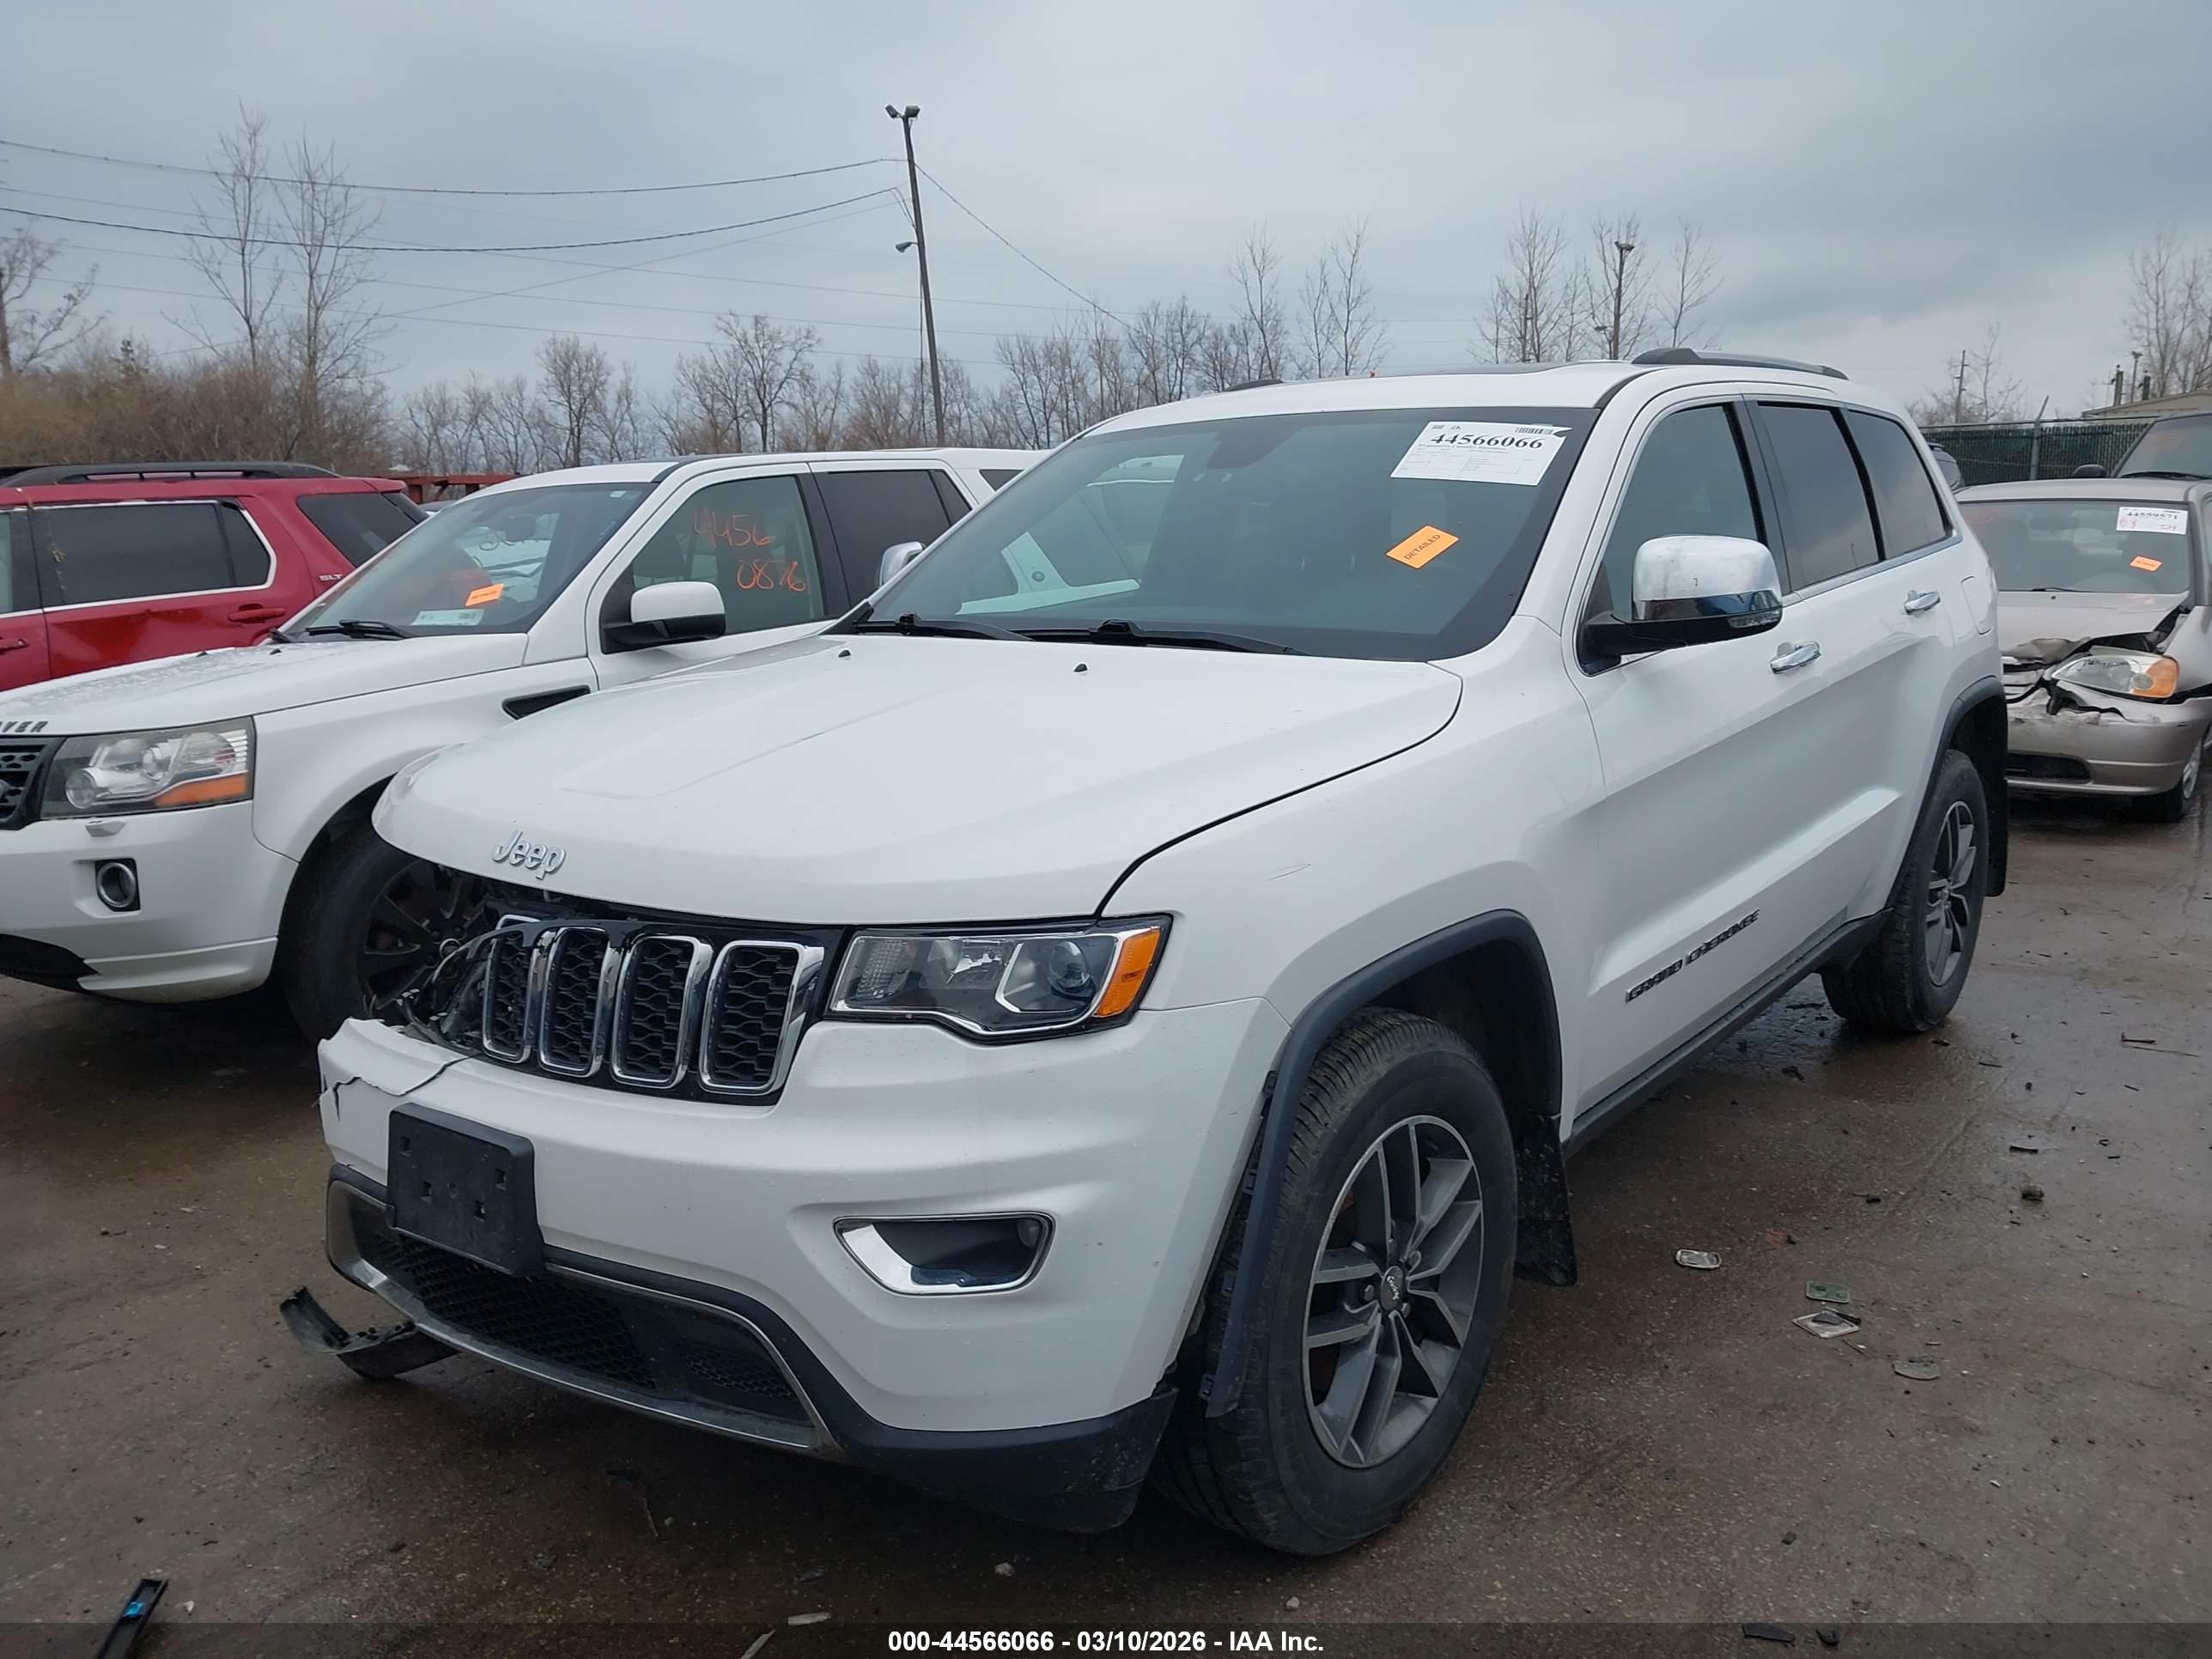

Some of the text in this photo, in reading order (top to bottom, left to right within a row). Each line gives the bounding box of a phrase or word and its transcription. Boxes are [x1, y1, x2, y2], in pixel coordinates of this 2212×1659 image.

[1431, 433, 1545, 449] 44566066
[694, 507, 774, 548] 4456
[1403, 534, 1441, 561] DETAILED
[319, 574, 343, 582] SLT
[0, 721, 48, 732] VER
[492, 830, 567, 880] Jeep
[1626, 908, 1760, 1003] GRAND CHEROKEE
